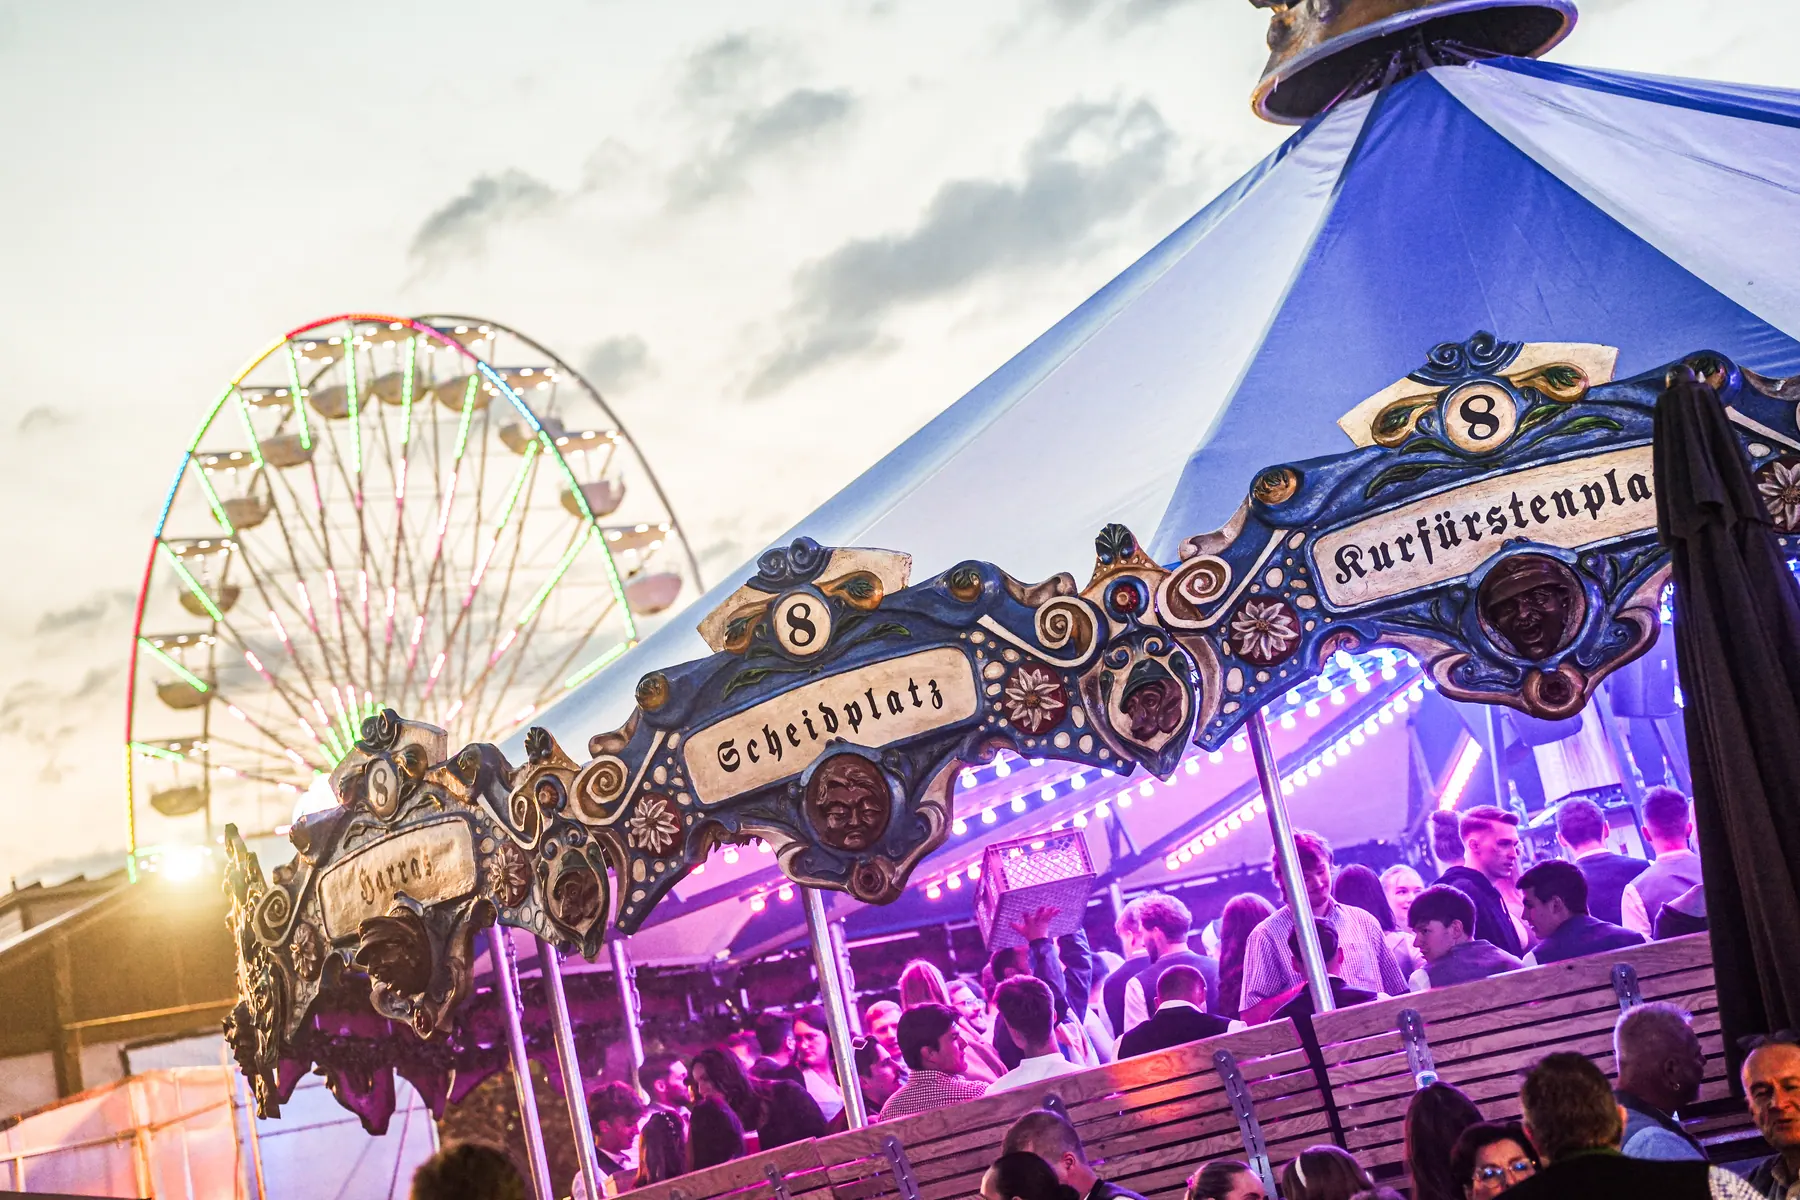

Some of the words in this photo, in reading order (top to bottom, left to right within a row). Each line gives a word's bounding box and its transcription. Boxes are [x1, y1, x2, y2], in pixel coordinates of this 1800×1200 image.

[1459, 394, 1500, 440] 8
[1334, 467, 1654, 584] Kurfürstenpla
[785, 602, 817, 647] 8
[717, 677, 943, 773] Scheidplatz
[372, 767, 389, 807] 8
